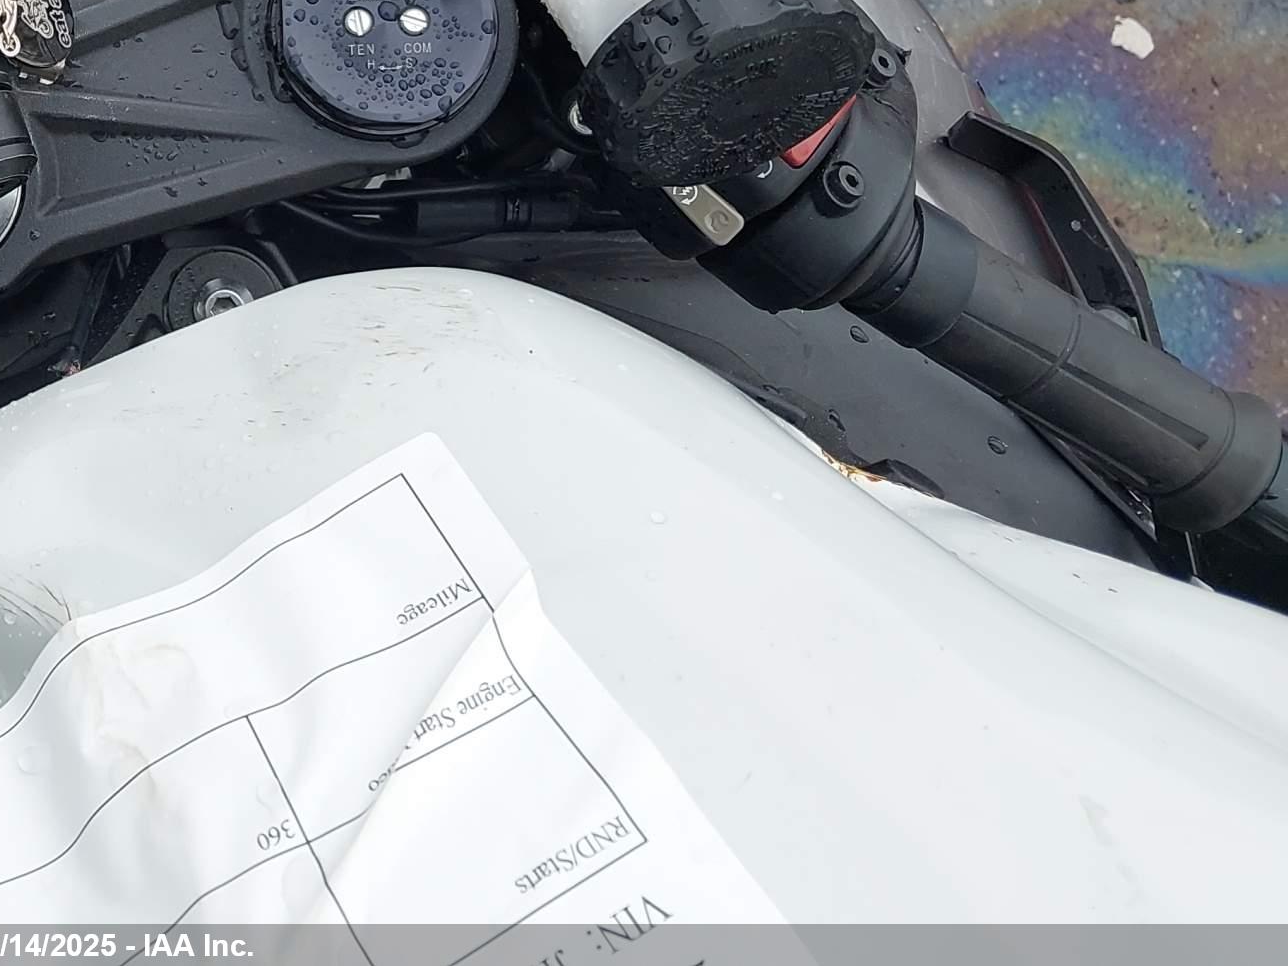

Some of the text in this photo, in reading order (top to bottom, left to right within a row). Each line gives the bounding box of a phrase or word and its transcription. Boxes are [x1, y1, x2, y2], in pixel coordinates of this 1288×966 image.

[49, 9, 72, 48] eat
[348, 42, 432, 56] TEN COM
[367, 57, 414, 70] H S
[396, 579, 473, 626] Mileage
[413, 675, 522, 741] Engine Start
[257, 819, 295, 850] 360
[514, 816, 630, 894] RND/Starts
[586, 896, 674, 954] VIN:
